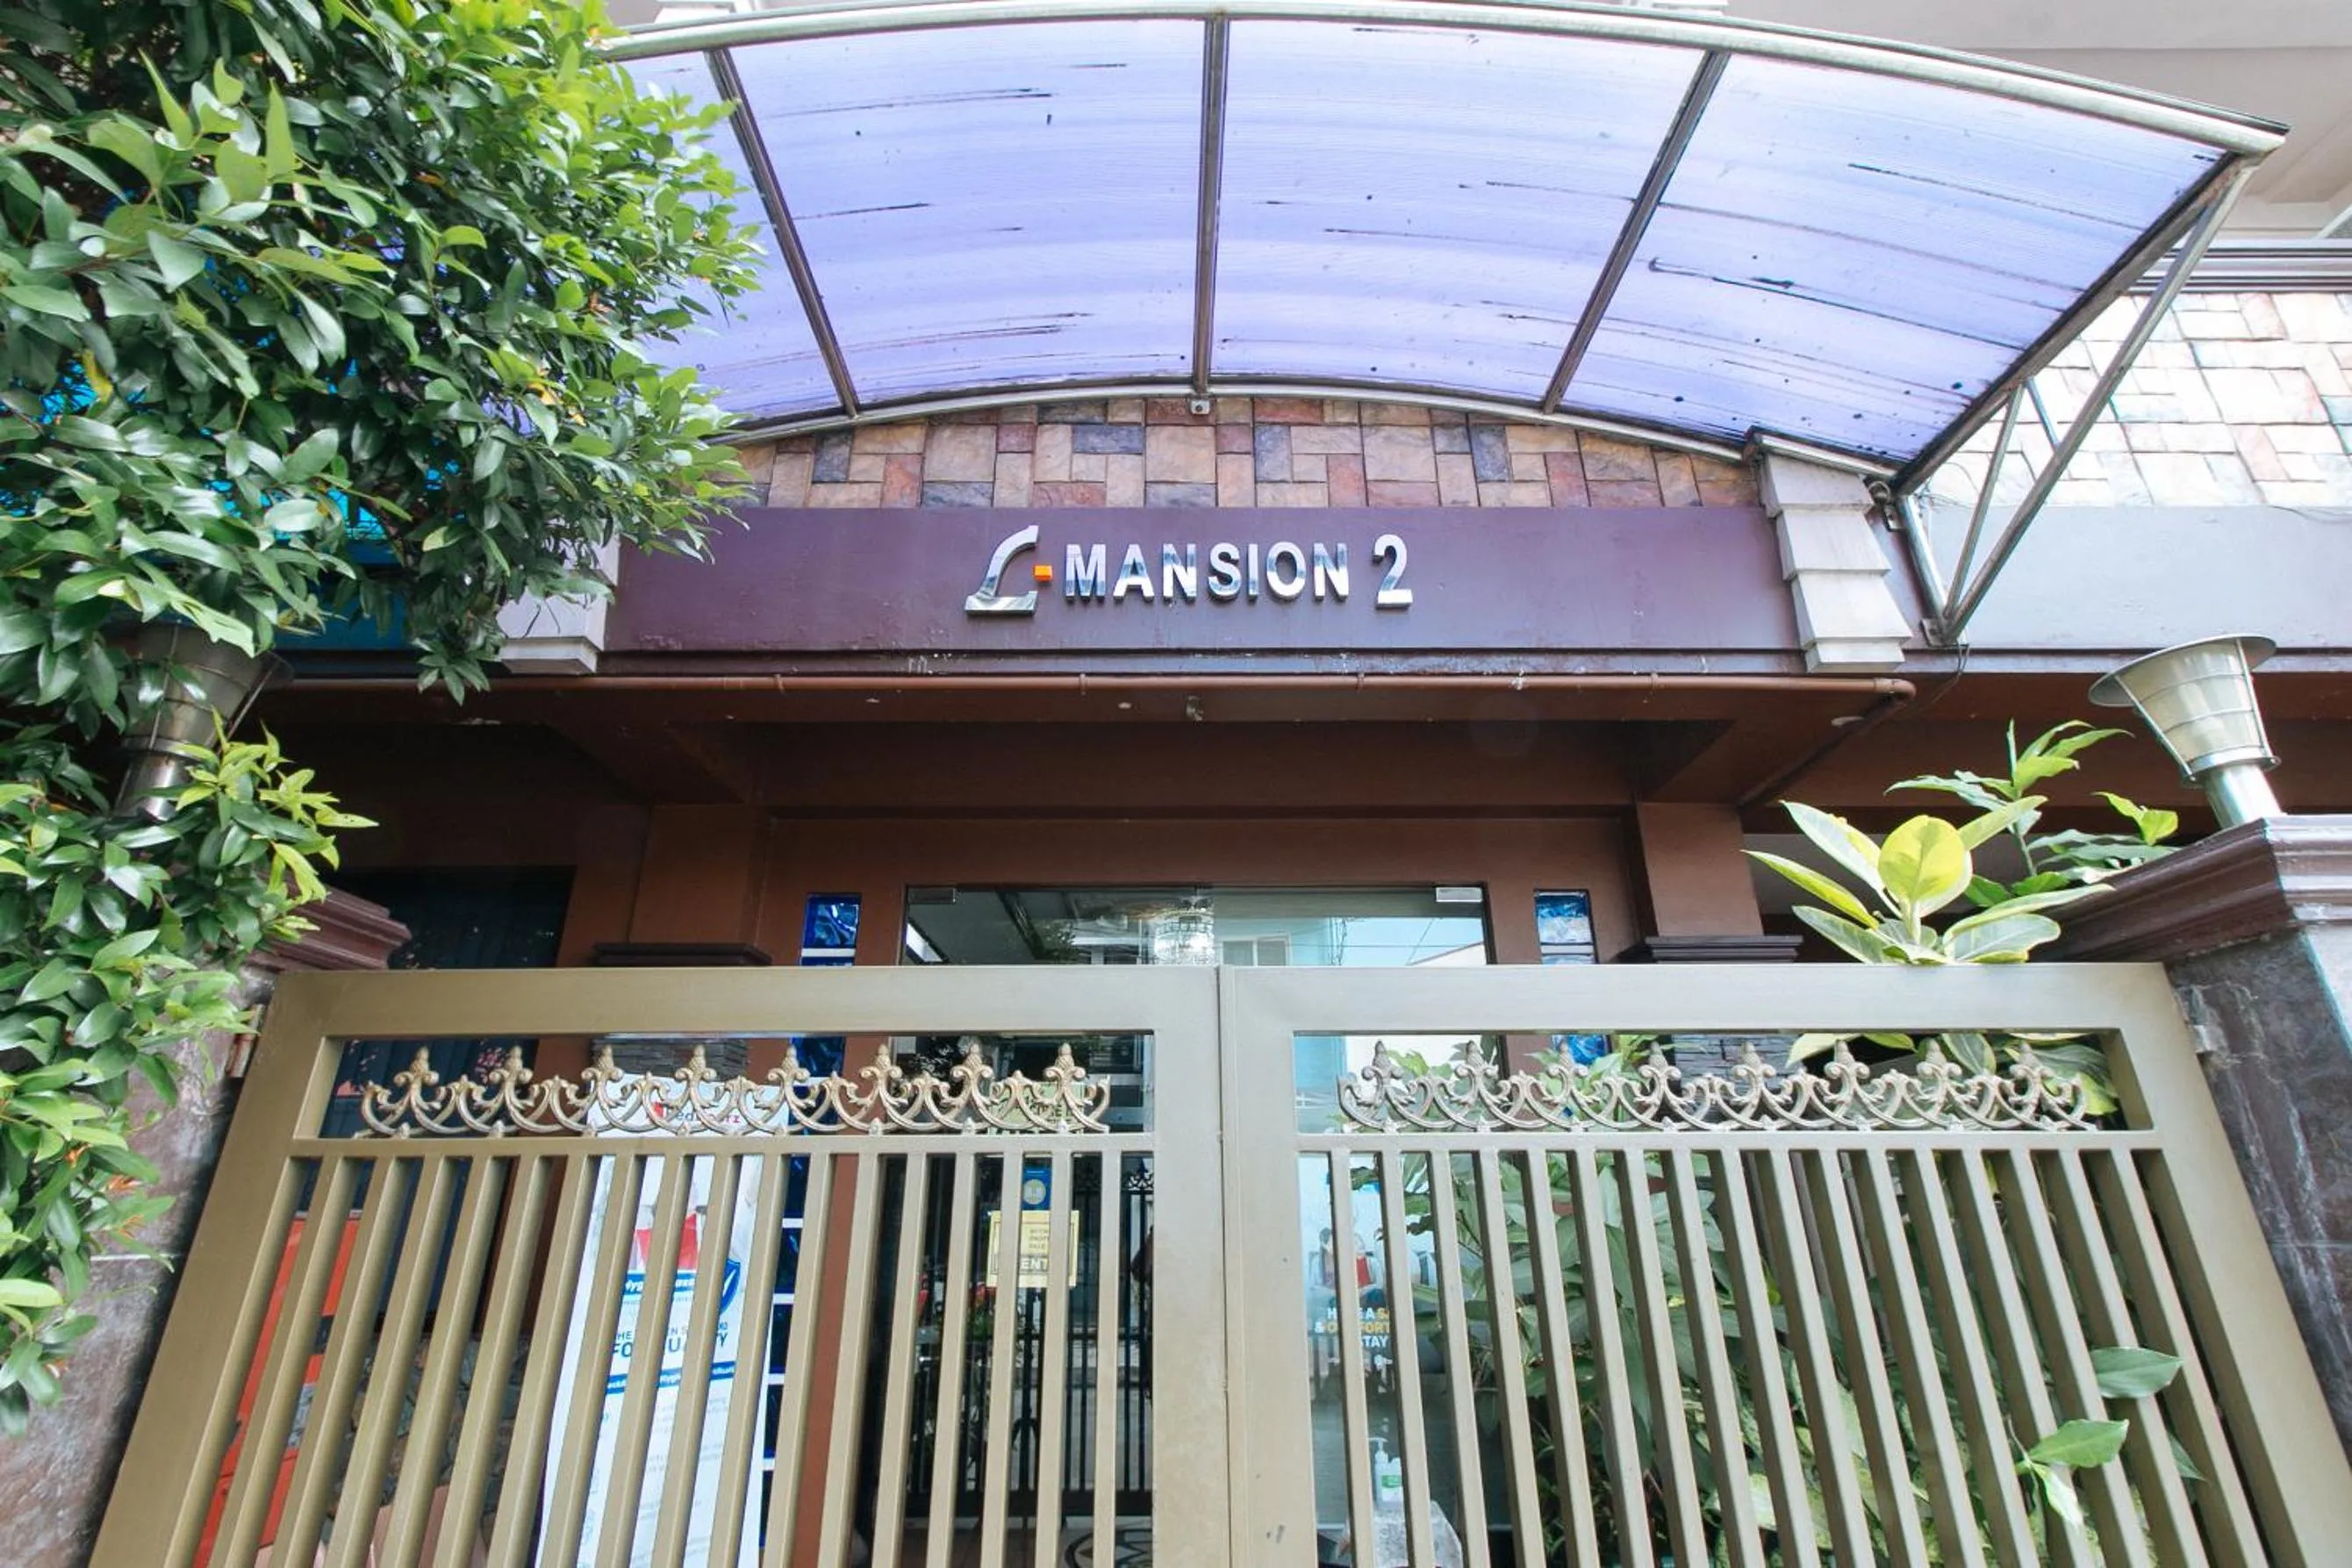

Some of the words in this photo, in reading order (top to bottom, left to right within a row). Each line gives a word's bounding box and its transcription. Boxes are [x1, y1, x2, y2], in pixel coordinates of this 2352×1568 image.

[1065, 541, 1350, 603] MANSION
[1373, 533, 1413, 610] 2
[1362, 1335, 1388, 1348] TAY
